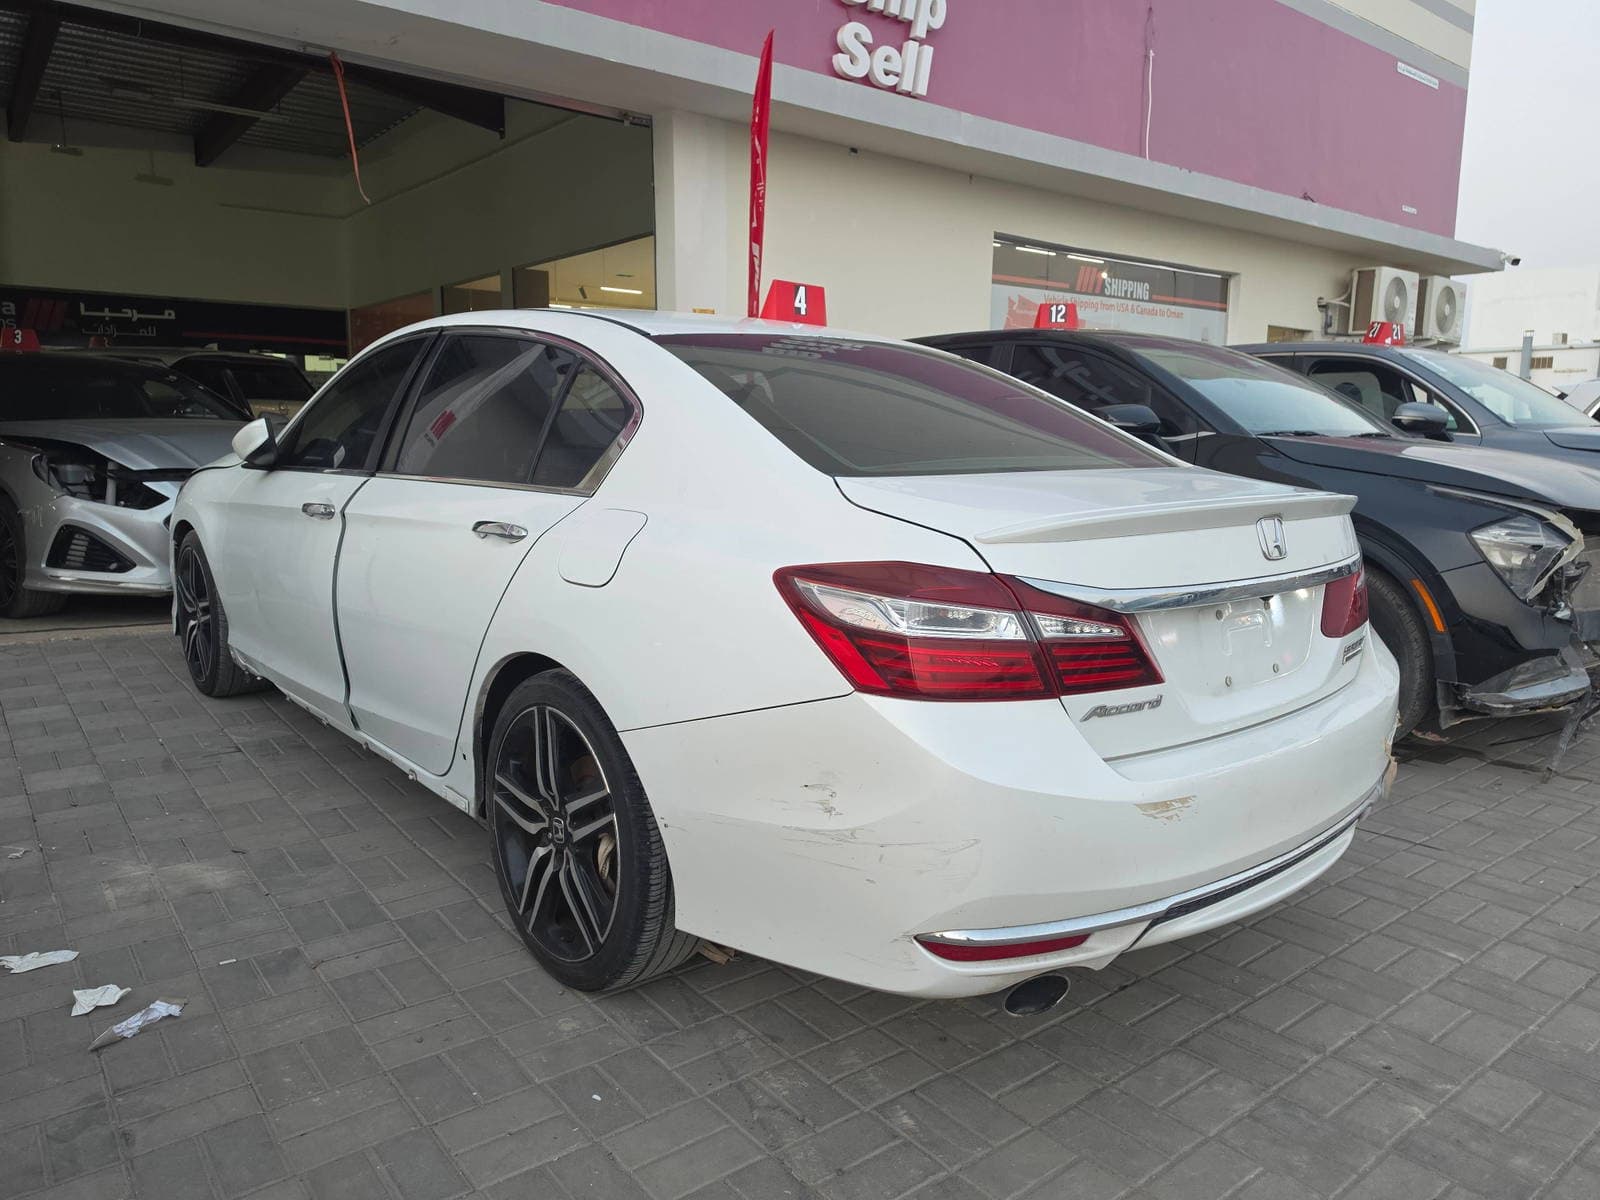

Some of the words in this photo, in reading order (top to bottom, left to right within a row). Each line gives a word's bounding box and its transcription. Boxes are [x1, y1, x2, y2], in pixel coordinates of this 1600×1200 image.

[832, 22, 934, 96] Sell
[1104, 277, 1150, 300] SHIPPING
[794, 286, 807, 315] 4
[1100, 301, 1116, 312] from
[1116, 303, 1129, 313] USA
[1136, 305, 1158, 317] Canada
[80, 302, 176, 322] مرحبا
[1050, 304, 1066, 323] 12
[14, 329, 22, 344] 3
[1392, 324, 1401, 340] 21
[1080, 694, 1163, 722] Accord
